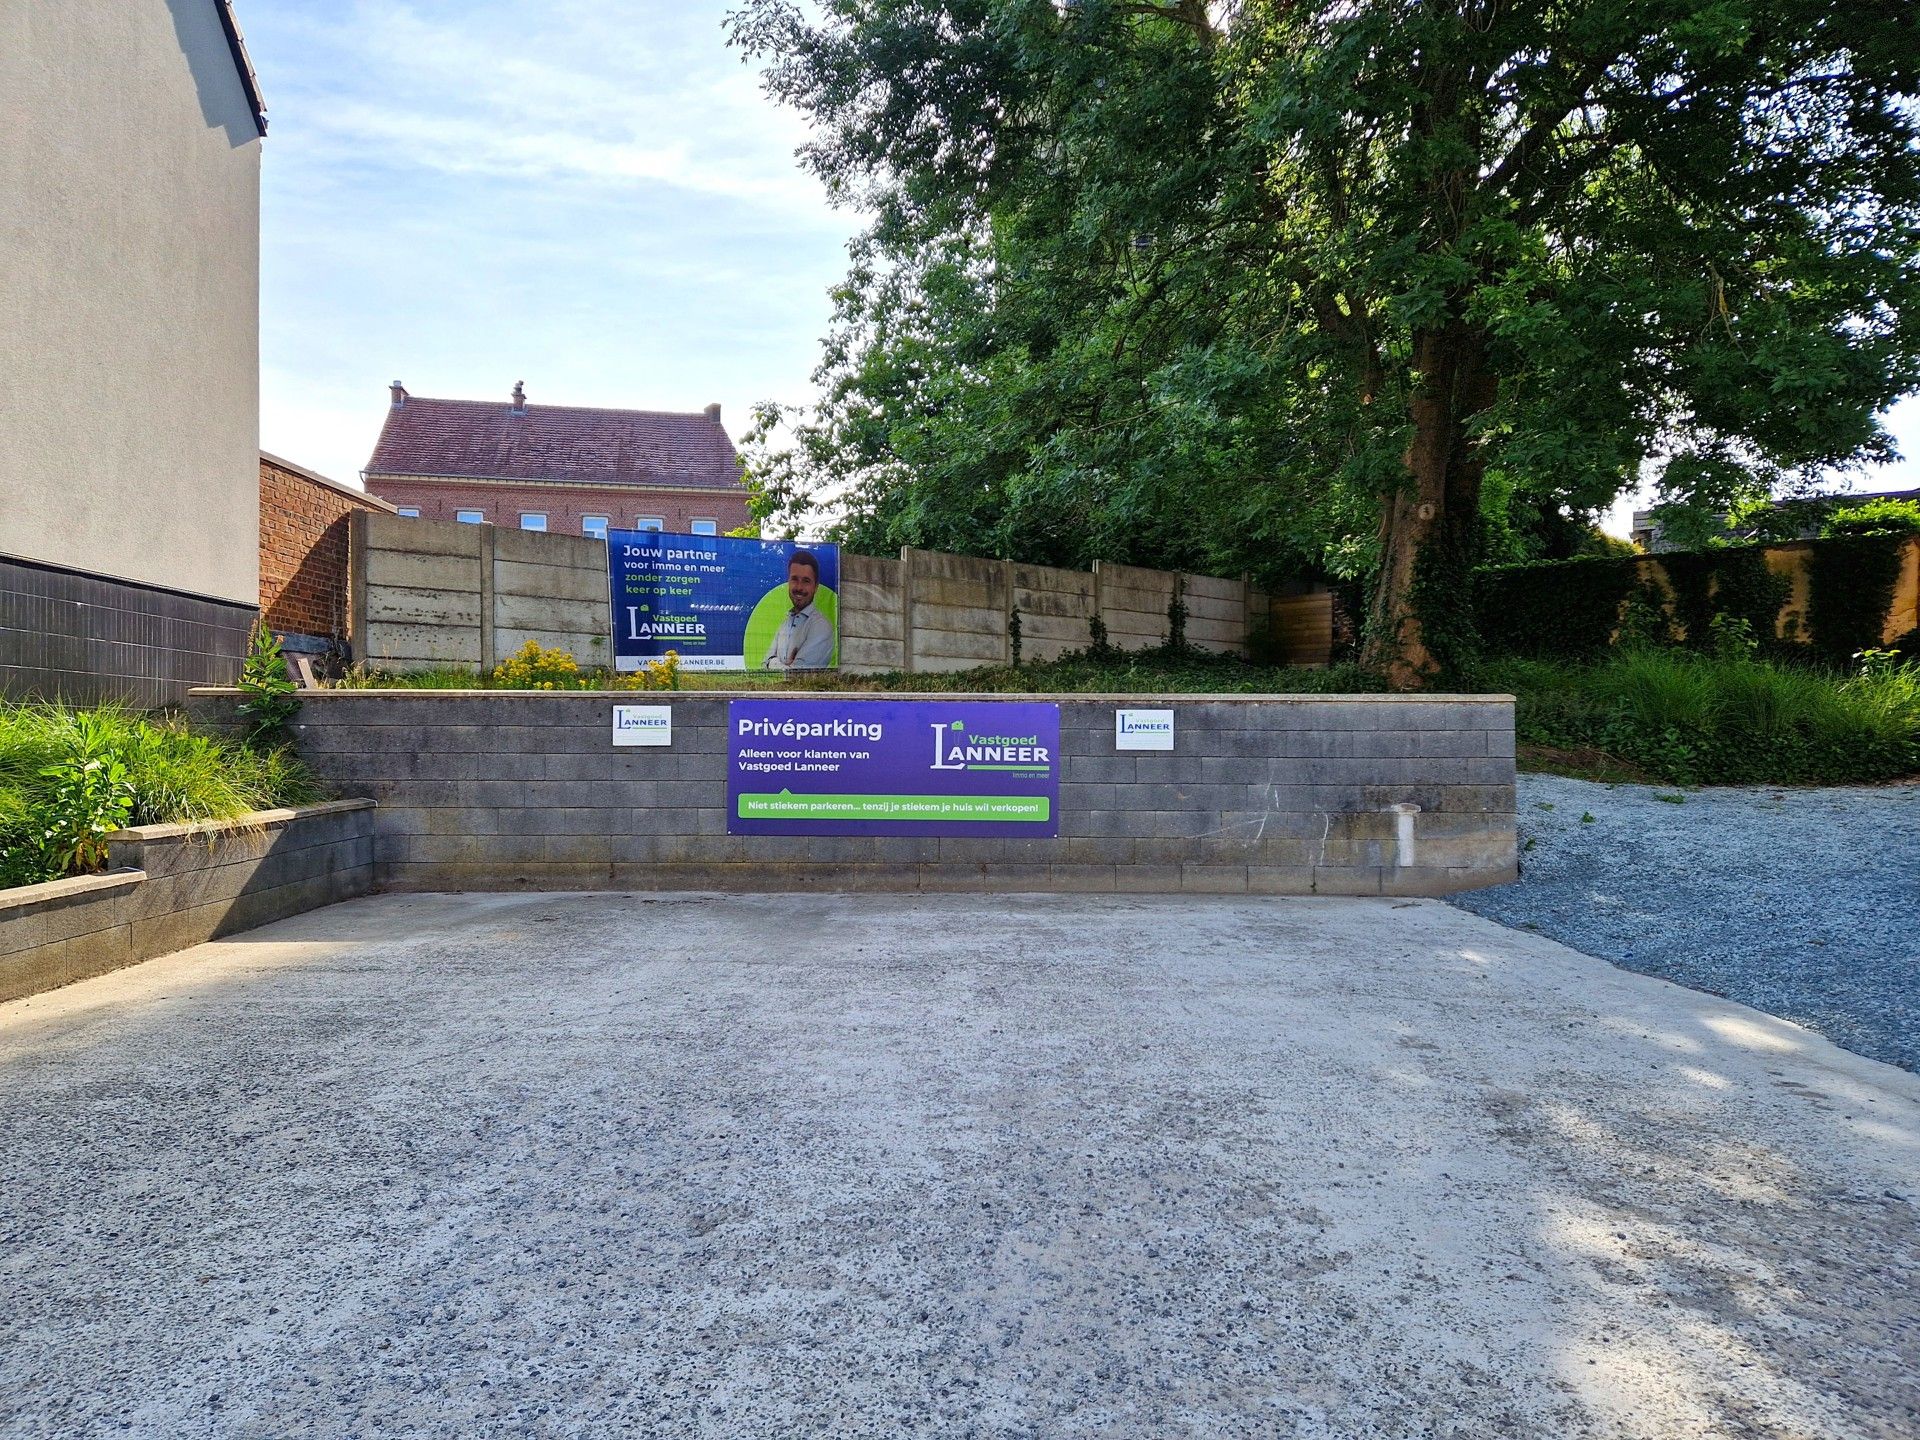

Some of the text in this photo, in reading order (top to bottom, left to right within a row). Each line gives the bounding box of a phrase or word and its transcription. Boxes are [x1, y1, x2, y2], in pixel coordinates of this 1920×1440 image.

[623, 545, 717, 561] Jouw partner
[624, 561, 725, 573] voor immo en meer
[625, 573, 701, 585] zonder zorgen
[625, 585, 692, 596] keer op keer
[626, 606, 706, 640] LANNEER
[653, 614, 698, 624] Vastgoed
[616, 709, 668, 730] LANNEER
[1119, 713, 1170, 734] LANNEER
[738, 718, 883, 741] Privéparking
[930, 723, 1050, 770] LANNEER
[968, 734, 1038, 747] Vastgoed
[738, 749, 774, 759] Alleen
[804, 750, 847, 759] klanten
[738, 762, 840, 773] Vastgoed Lanneer
[748, 801, 1039, 813] Niet stiekem parkeren... tenzij je stiekem je huis wil verkopen!
